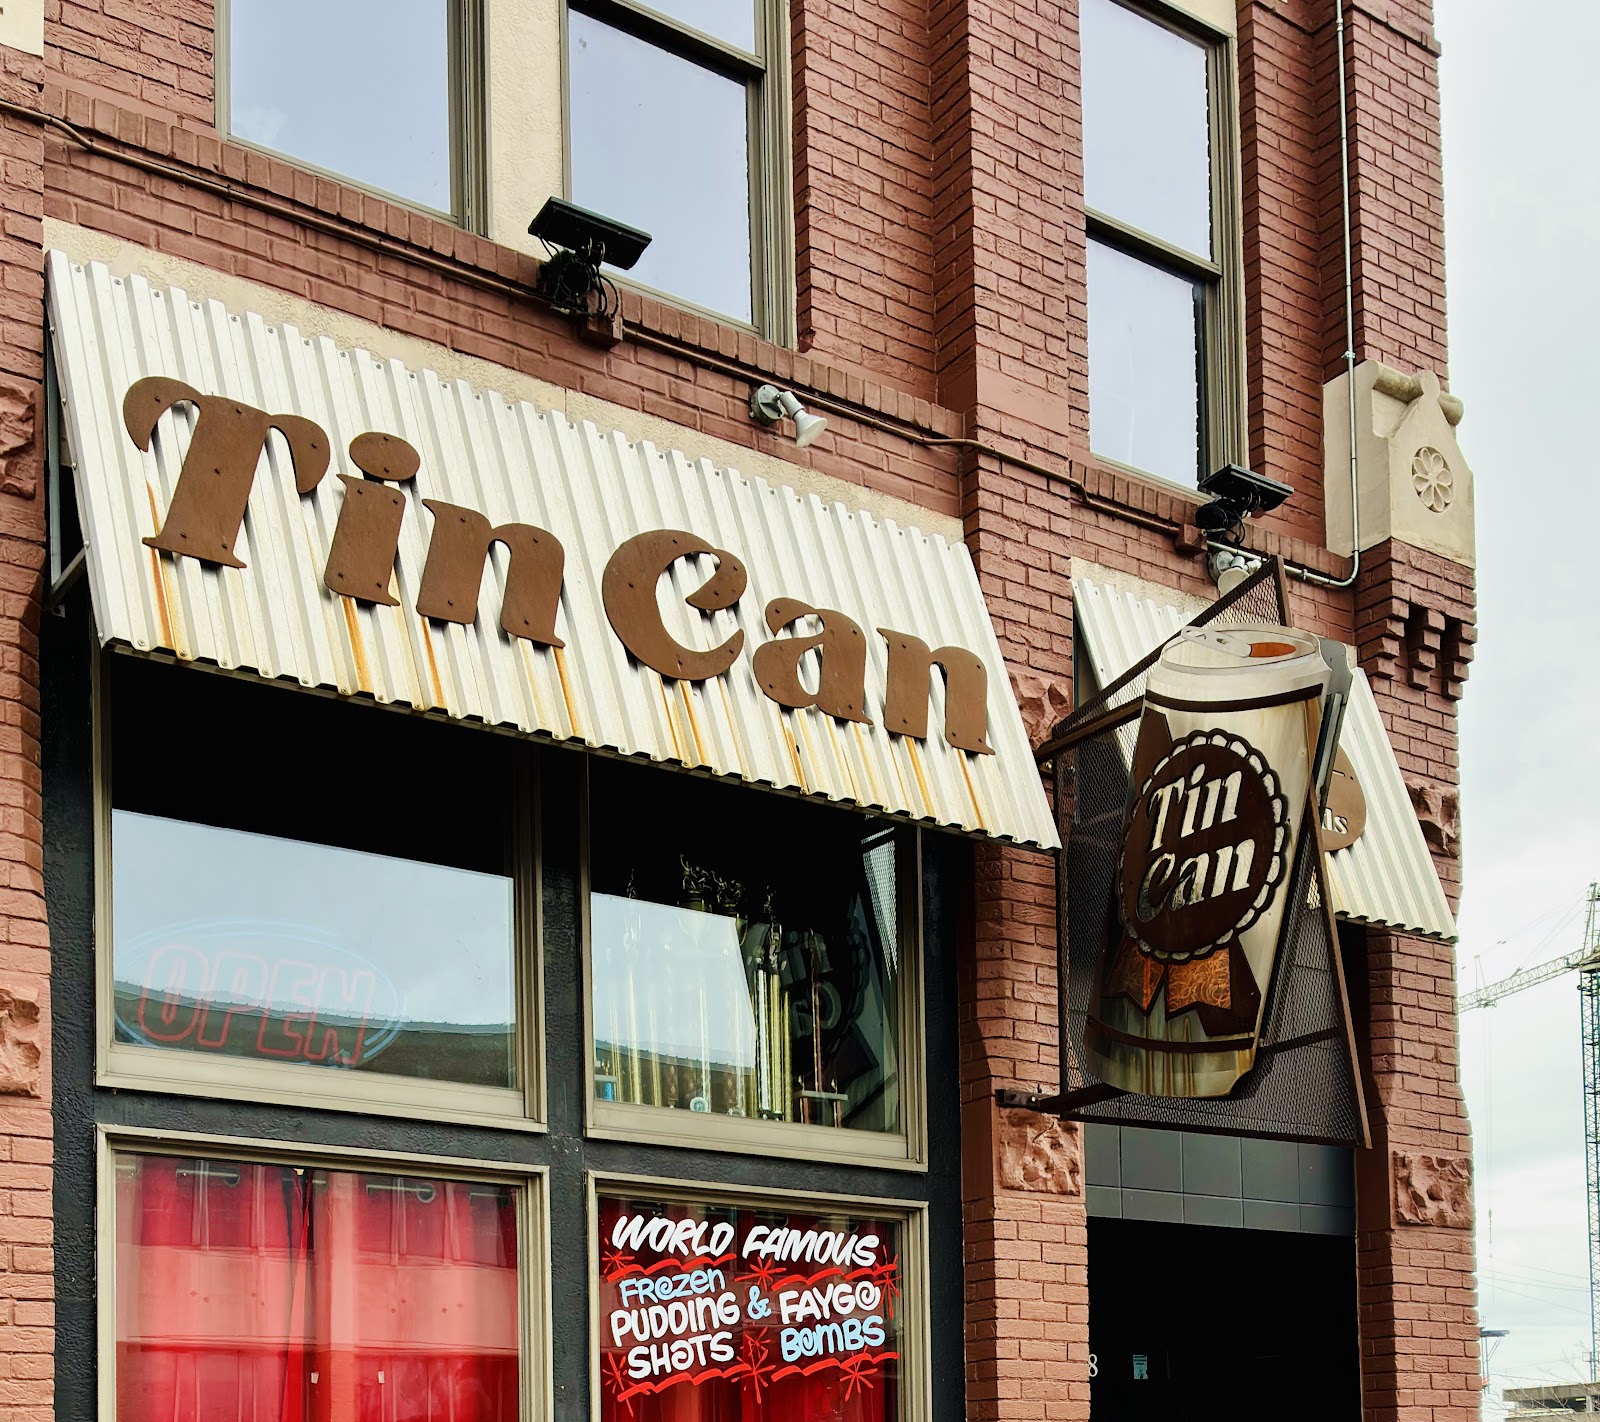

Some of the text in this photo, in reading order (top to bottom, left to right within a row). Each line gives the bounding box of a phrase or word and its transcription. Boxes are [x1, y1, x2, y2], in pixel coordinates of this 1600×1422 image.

[123, 376, 994, 755] Tin Can
[1146, 763, 1242, 851] Tin
[1136, 839, 1255, 923] Can
[136, 943, 377, 1065] OPEN
[611, 1214, 880, 1266] WORLD FAMOUS
[747, 1286, 771, 1319] &
[779, 1281, 881, 1324] FAYGO
[627, 1332, 734, 1379] SHOTS
